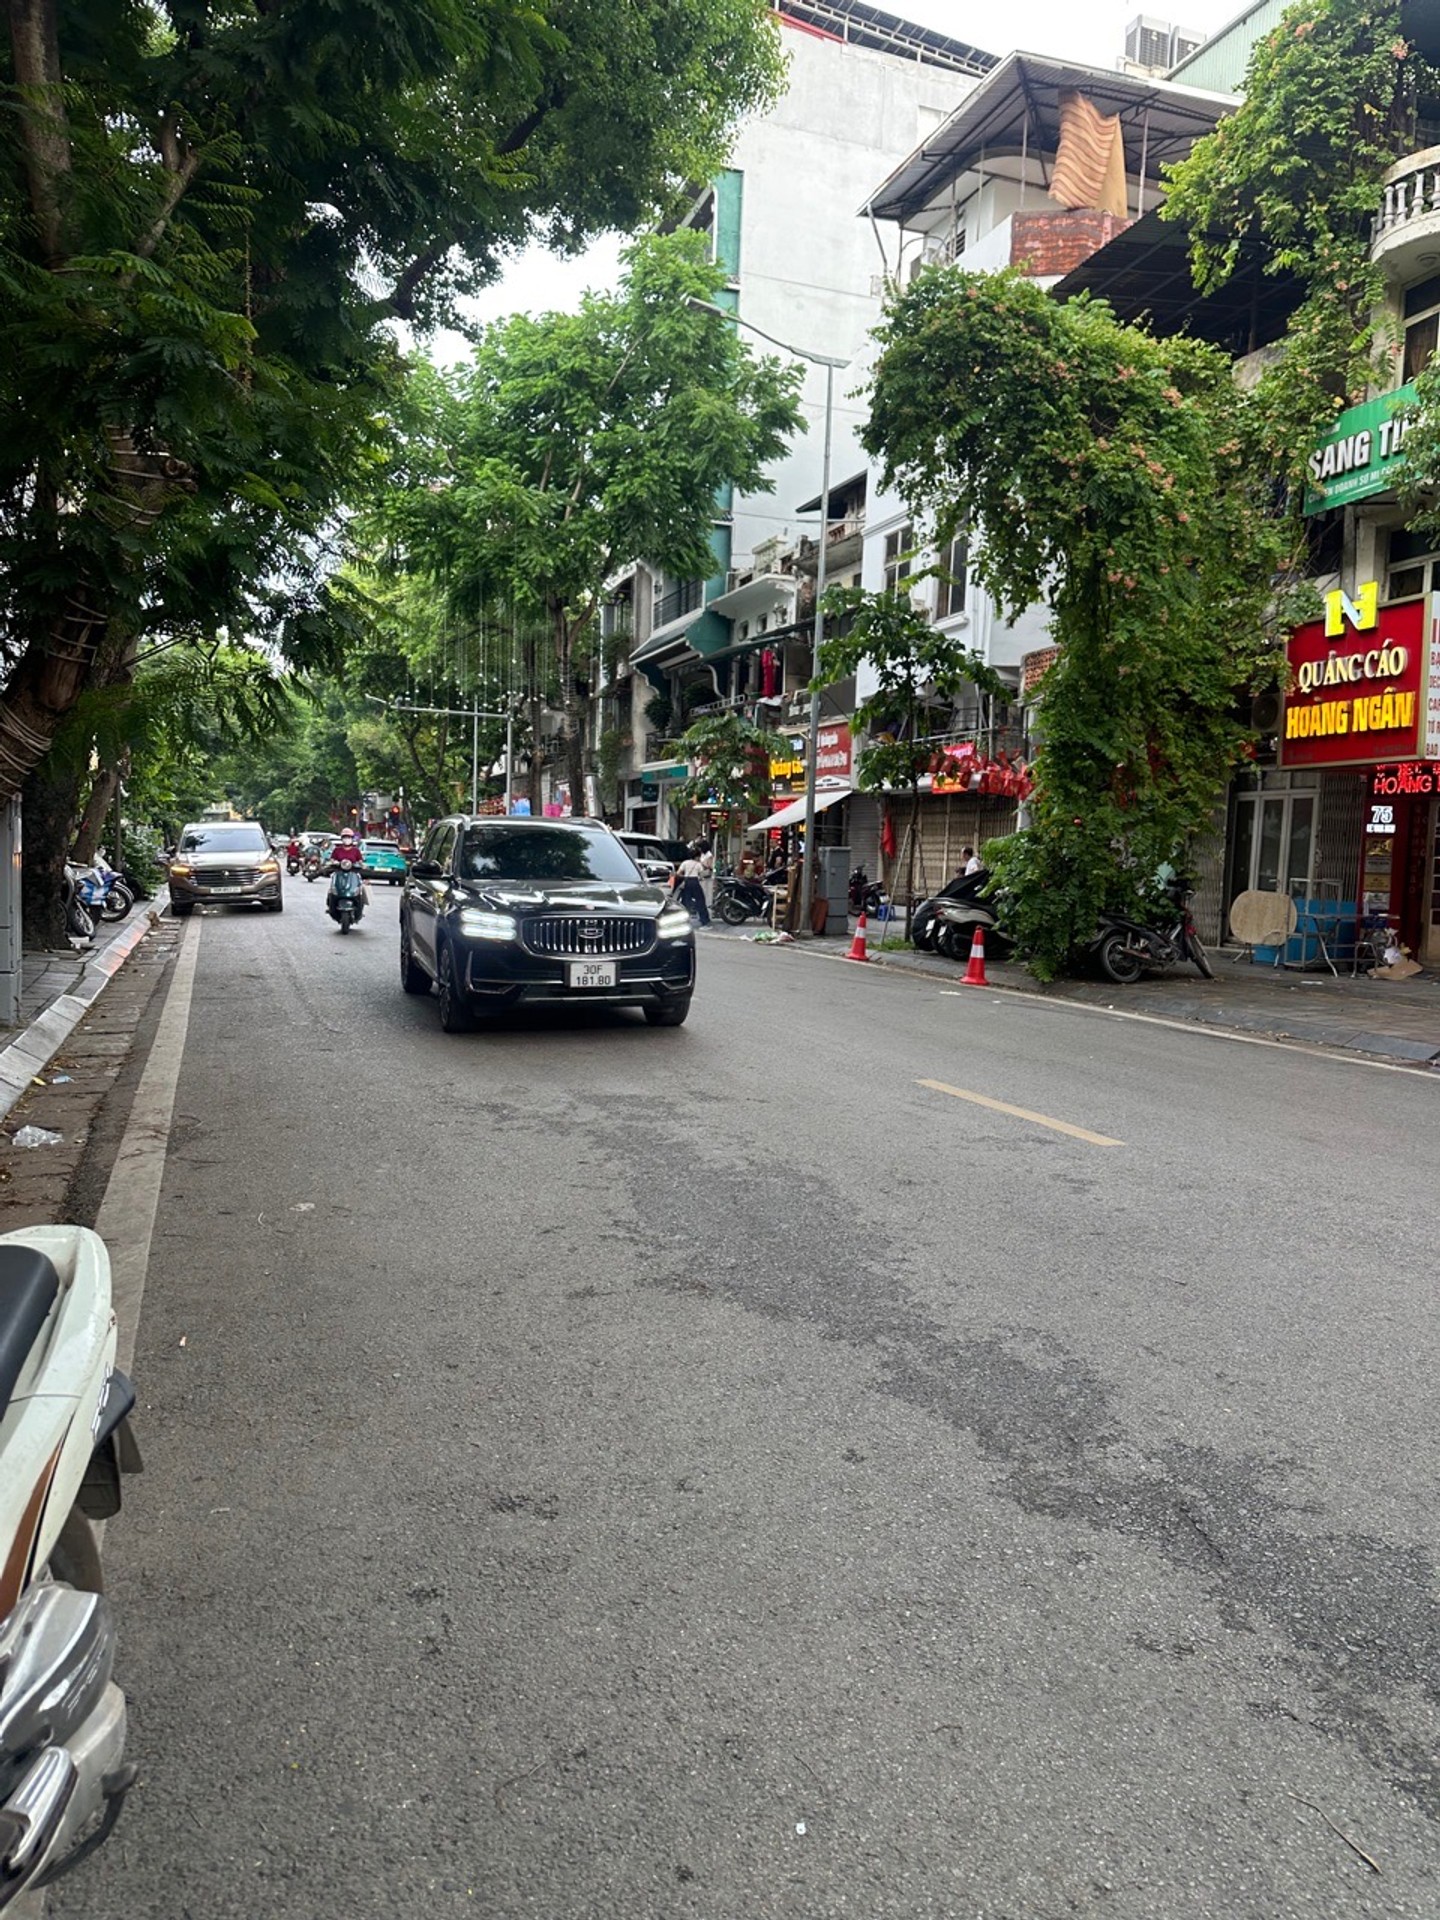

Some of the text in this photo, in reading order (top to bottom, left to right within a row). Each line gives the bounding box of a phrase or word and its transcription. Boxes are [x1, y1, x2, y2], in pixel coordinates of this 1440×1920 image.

[1308, 430, 1371, 480] SANG
[1298, 638, 1408, 693] QUẢNG CÁO
[1286, 686, 1416, 739] HOÀNG NGÂN
[583, 964, 603, 975] 30F
